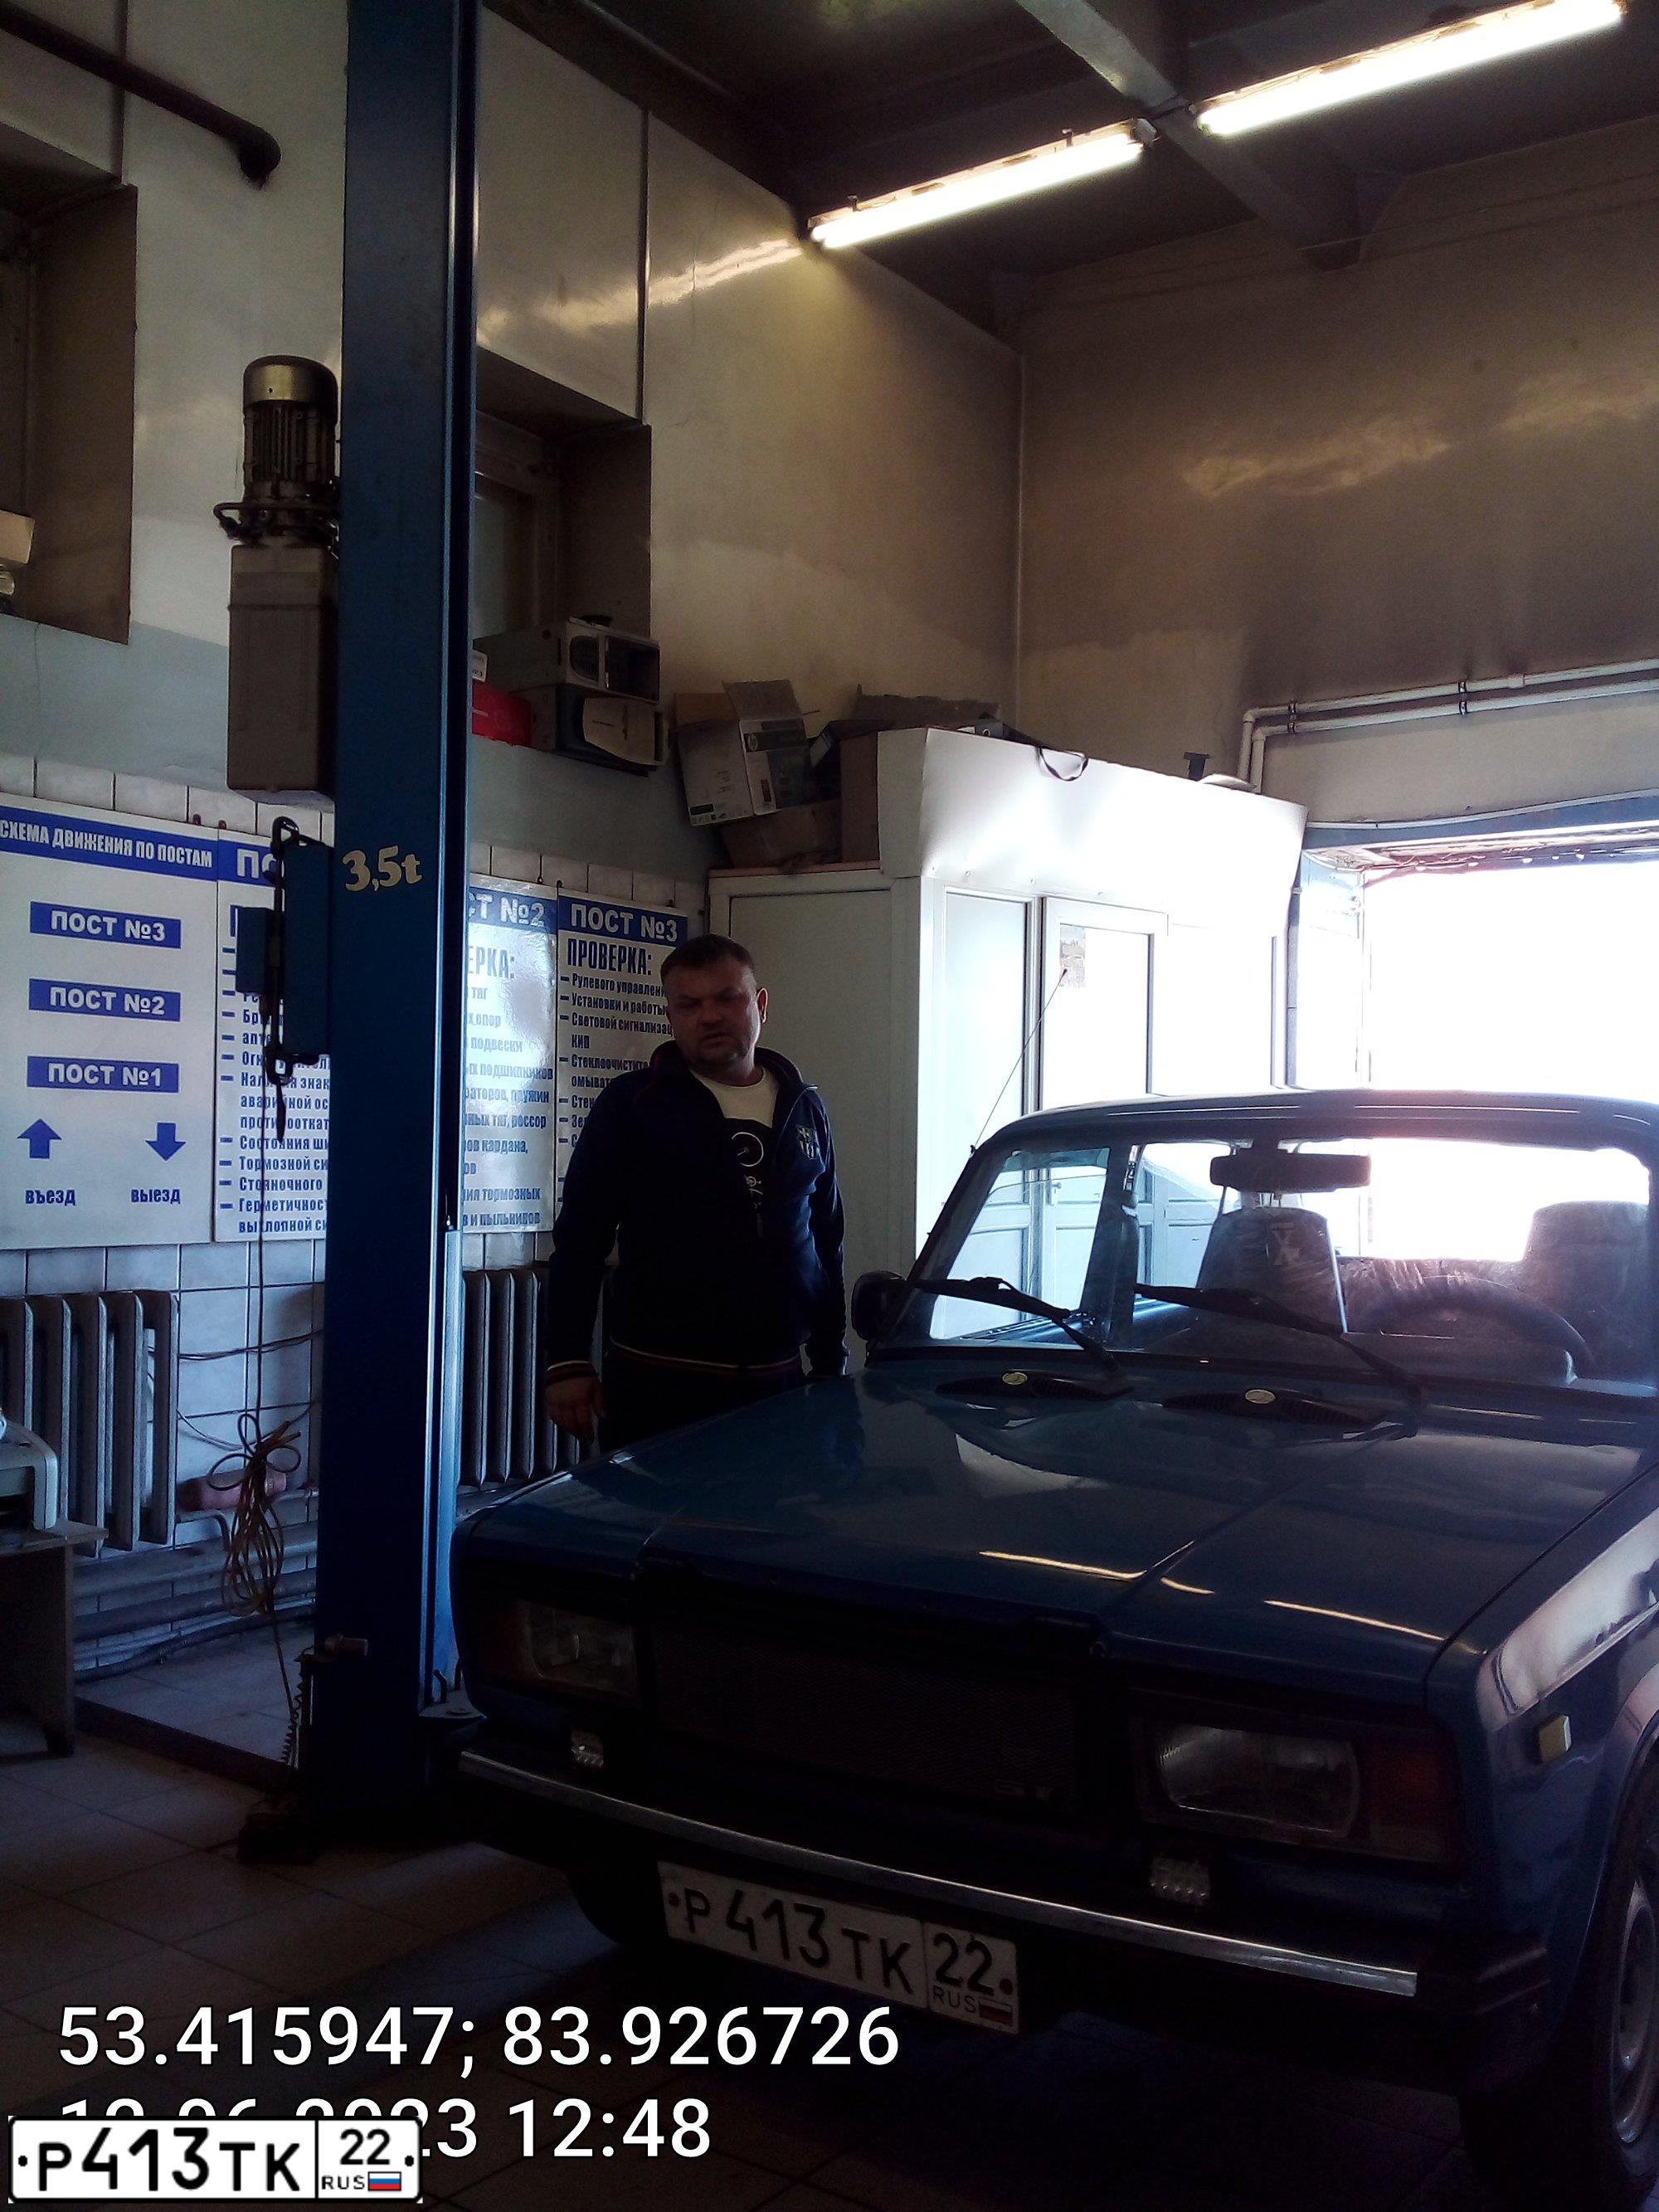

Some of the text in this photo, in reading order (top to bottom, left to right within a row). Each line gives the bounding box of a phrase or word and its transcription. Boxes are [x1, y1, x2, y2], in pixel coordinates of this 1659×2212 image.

[0, 819, 213, 869] СХЕМА ДВИЖЕНИЯ ПО ПОСТАМ
[342, 844, 423, 892] 3,5t
[499, 897, 545, 928] №2
[51, 909, 166, 943] ПОСТ №3
[571, 903, 678, 943] ПОСТ №3
[567, 938, 652, 976] ПРОВЕРКА:
[572, 972, 615, 992] Рулевого
[50, 986, 166, 1016] ПОСТ №2
[572, 992, 622, 1011] Установки
[622, 1000, 630, 1012] и
[476, 1013, 502, 1029] опор
[572, 1011, 617, 1030] Световой
[470, 1037, 523, 1054] подвески
[48, 1062, 162, 1087] ПОСТ №1
[479, 1063, 554, 1080] подшипников
[511, 1088, 550, 1104] пружин
[511, 1114, 547, 1129] рессор
[481, 1138, 528, 1155] кардана,
[238, 1155, 311, 1172] Тормозной
[239, 1176, 323, 1192] Стояночного
[24, 1189, 77, 1206] въезд
[130, 1188, 181, 1206] выезд
[482, 1186, 541, 1202] тормозных
[238, 1197, 328, 1214] Герметичнос
[238, 1216, 312, 1234] вылопной
[470, 1213, 478, 1226] и
[479, 1211, 541, 1226] пыльников
[932, 1932, 995, 1995] 22
[932, 1985, 977, 2014] RUS
